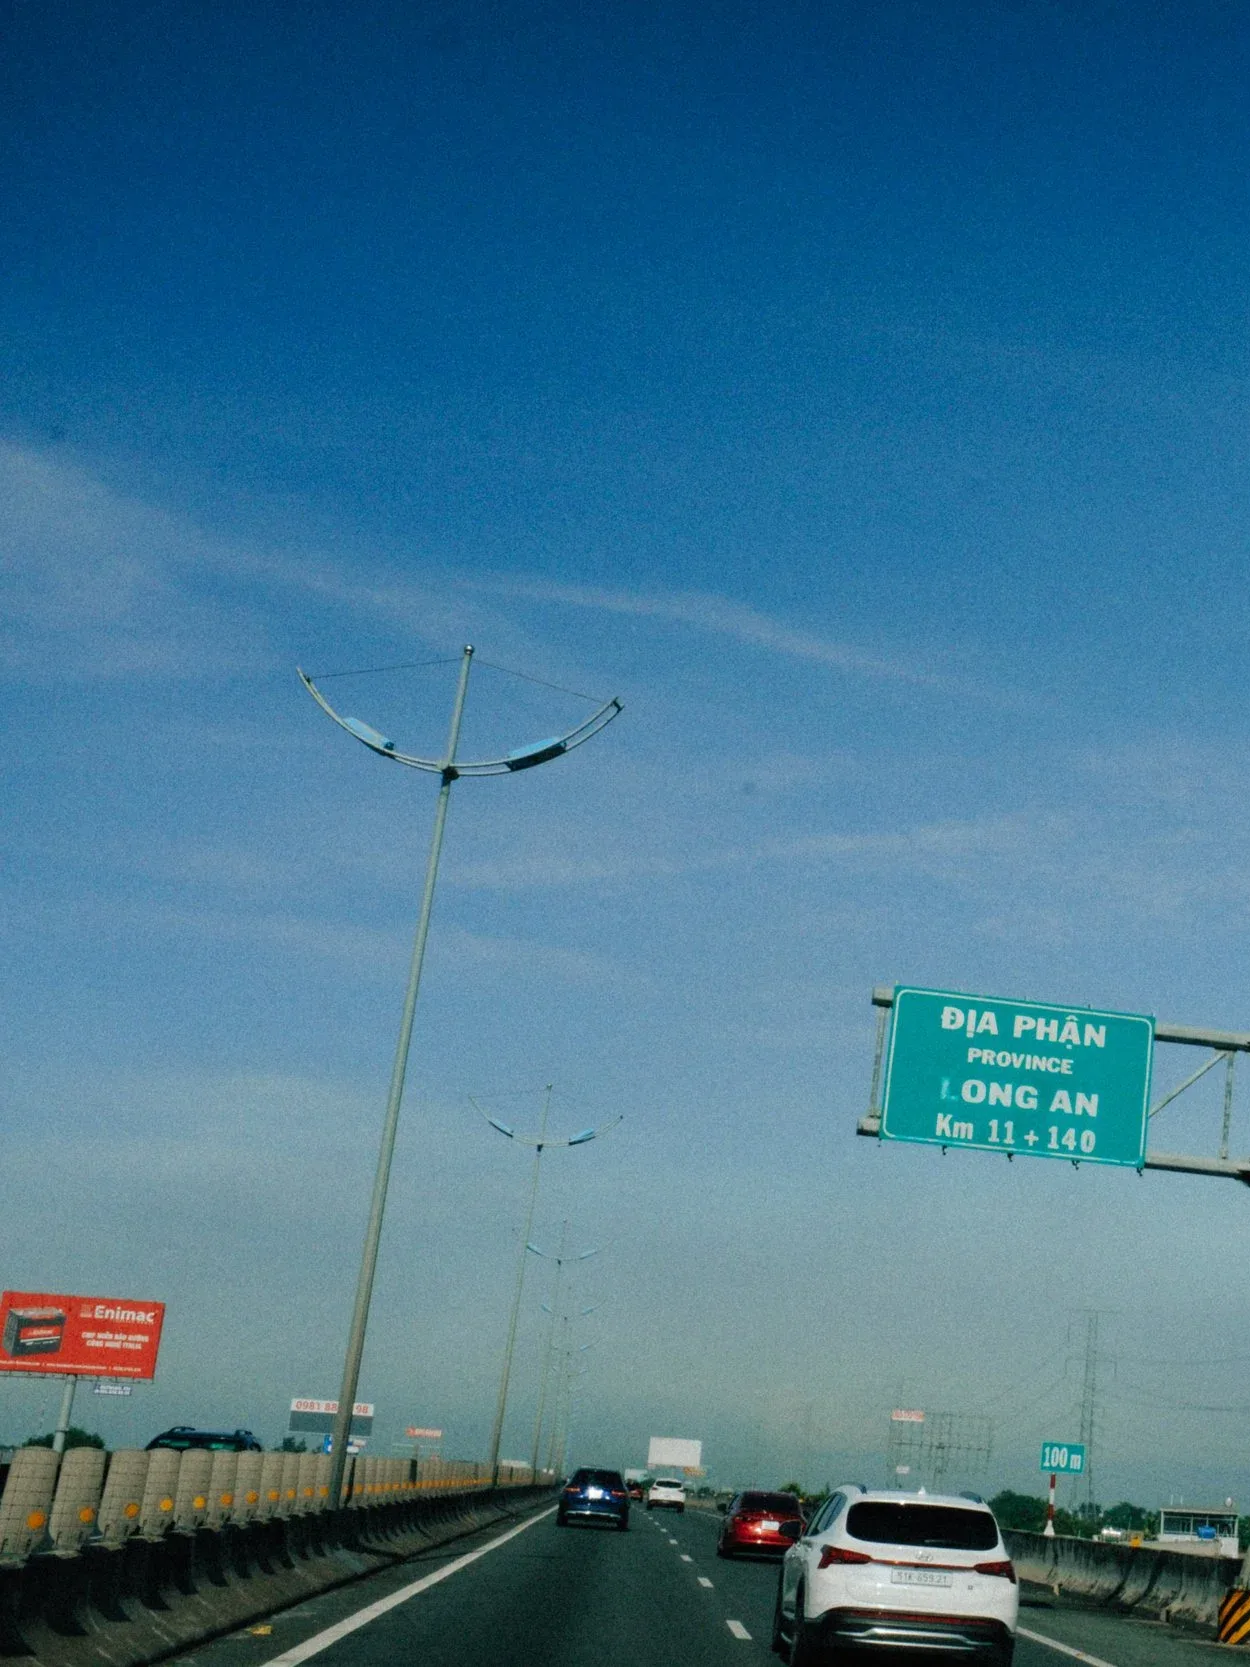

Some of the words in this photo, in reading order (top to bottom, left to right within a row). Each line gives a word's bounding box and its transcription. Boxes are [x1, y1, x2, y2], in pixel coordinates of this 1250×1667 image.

[940, 1006, 999, 1038] ĐỊA
[1012, 1014, 1107, 1050] PHẬN
[967, 1047, 1074, 1075] PROVINCE
[1049, 1089, 1099, 1118] AN
[935, 1112, 974, 1141] Km
[987, 1119, 1015, 1145] 11
[1047, 1125, 1097, 1154] 140
[94, 1305, 155, 1322] Enimac
[1043, 1446, 1068, 1468] 100
[1070, 1454, 1082, 1470] m
